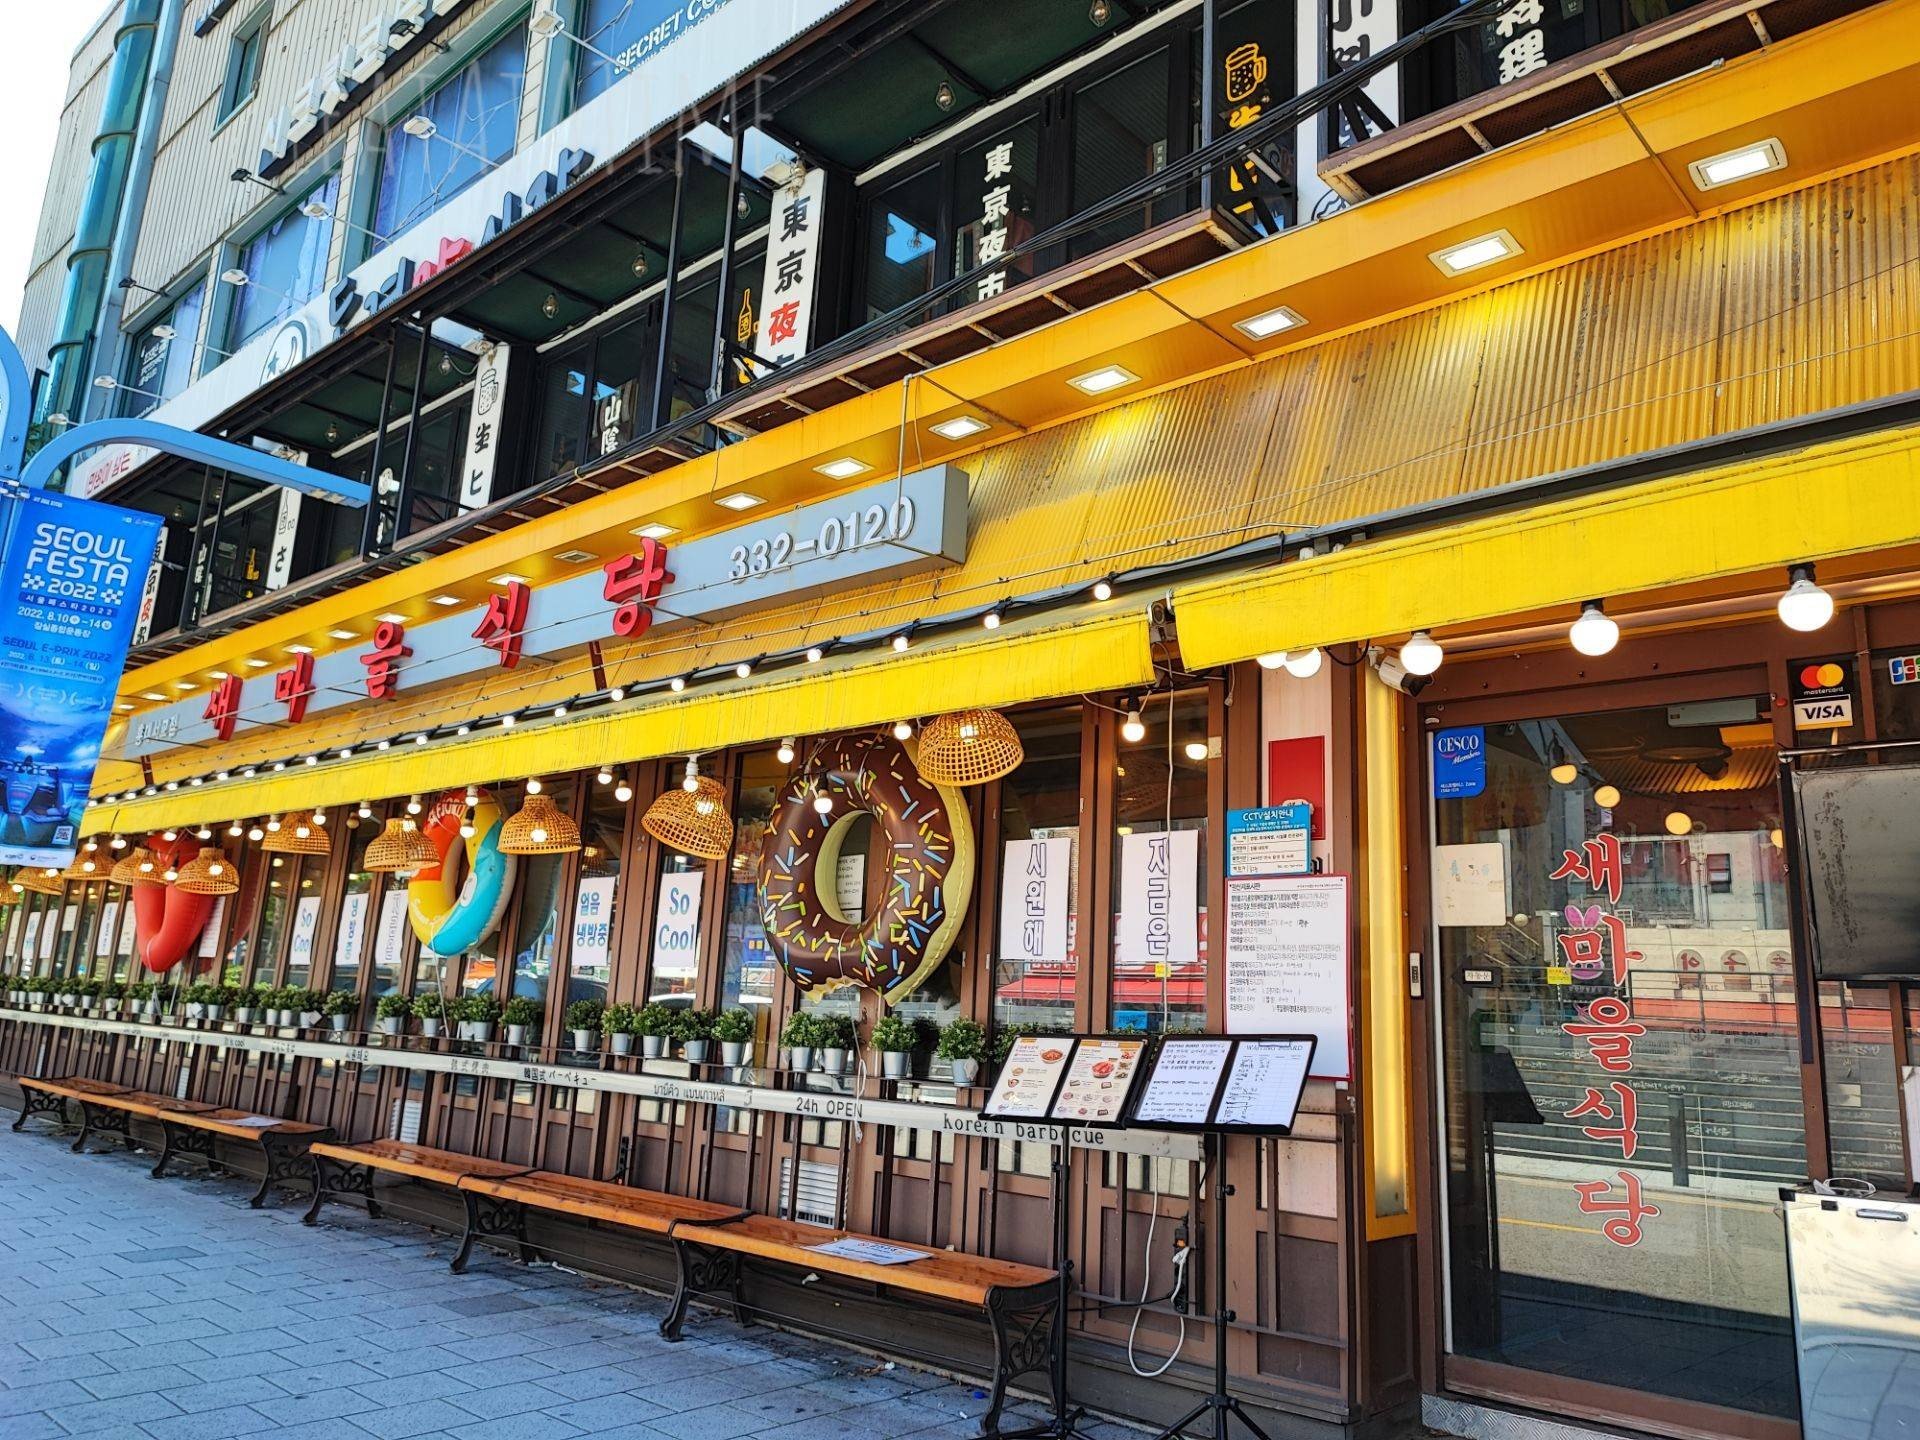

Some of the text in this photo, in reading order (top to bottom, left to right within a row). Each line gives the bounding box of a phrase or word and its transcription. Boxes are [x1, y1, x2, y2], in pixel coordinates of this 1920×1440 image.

[614, 8, 685, 75] SECRET
[33, 522, 133, 563] SEOUL
[728, 495, 915, 585] 332-0120
[26, 547, 130, 587] FESTA
[47, 578, 98, 601] 2022
[202, 537, 676, 741] 새마을식당
[1803, 686, 1844, 695] mastercard
[1801, 705, 1845, 720] VISA
[1438, 734, 1479, 753] CESCO
[669, 886, 690, 915] So
[1023, 842, 1047, 957] 시원해
[577, 922, 608, 948] 냉방중
[658, 923, 695, 951] Cool
[1549, 833, 1660, 1247] 새마을식당
[796, 1096, 863, 1119] 24h OPEN
